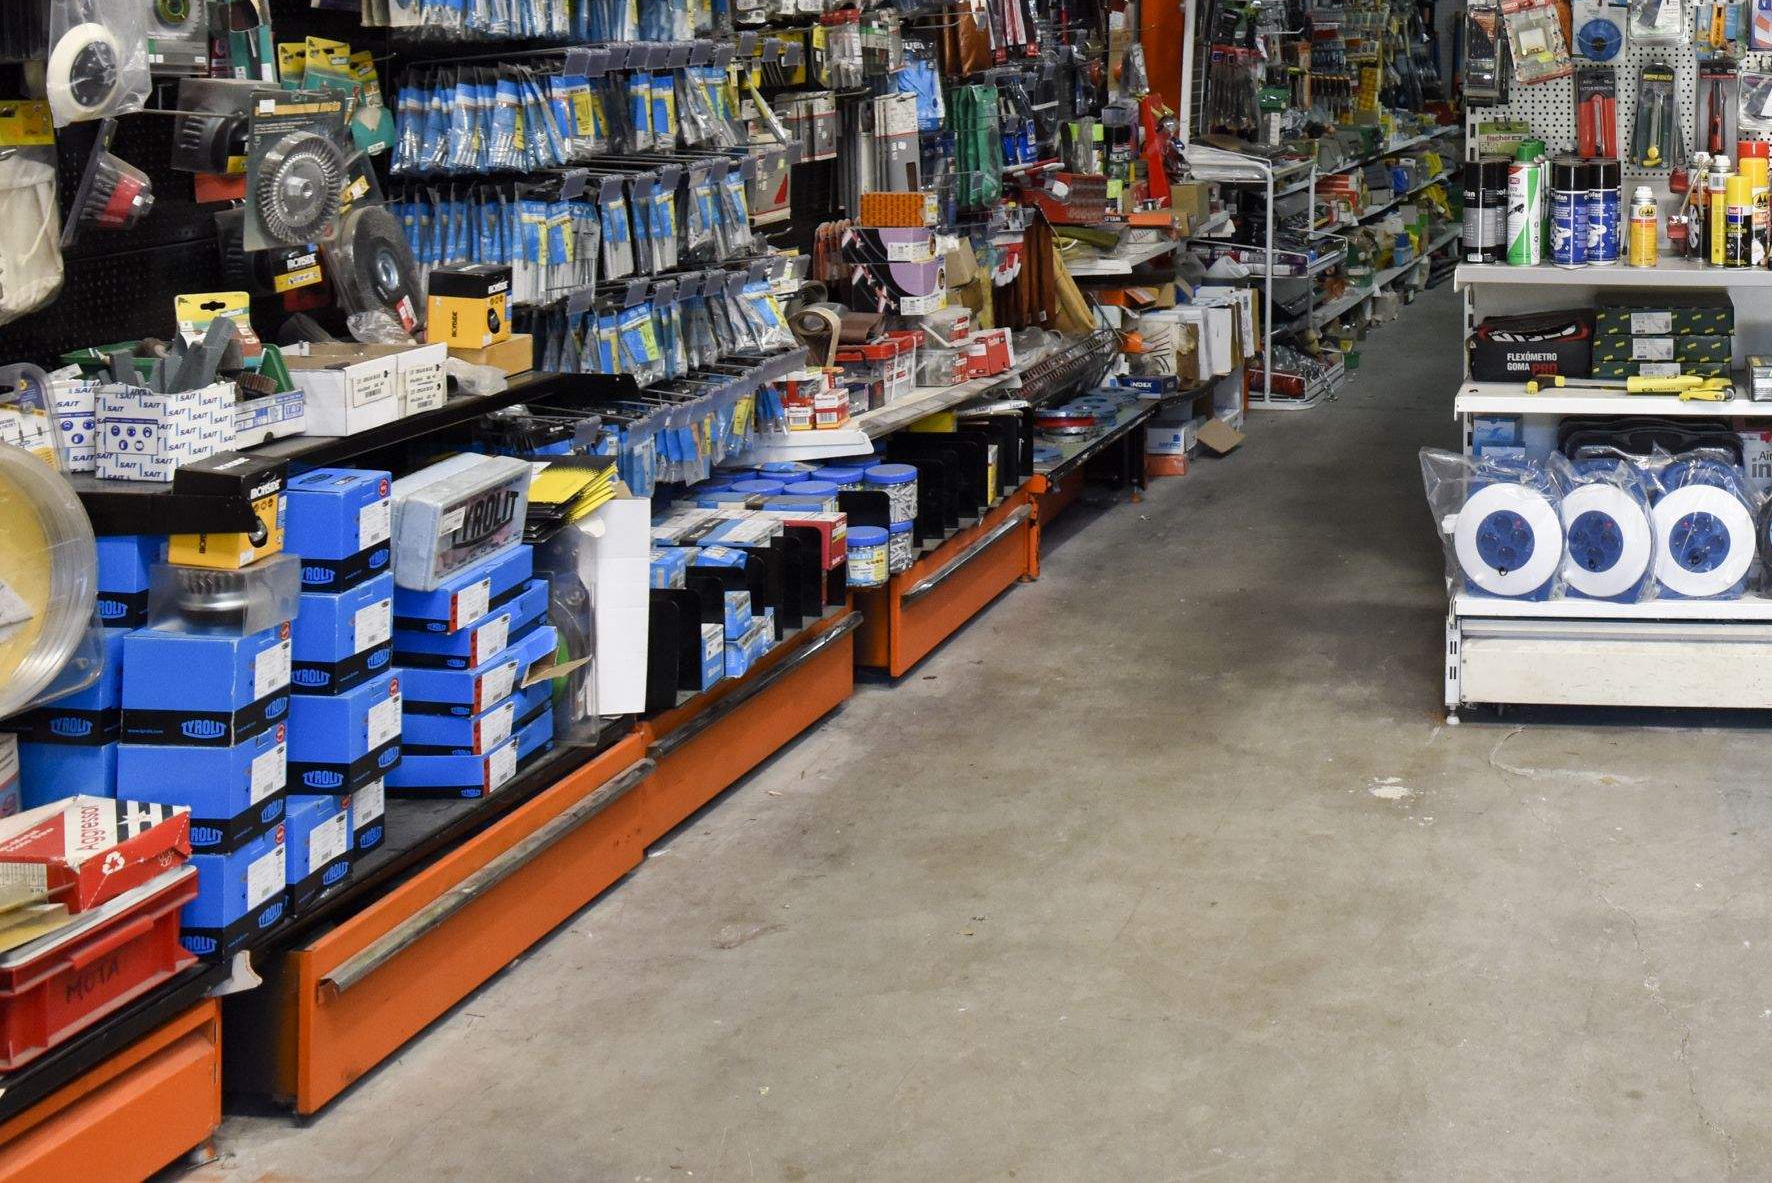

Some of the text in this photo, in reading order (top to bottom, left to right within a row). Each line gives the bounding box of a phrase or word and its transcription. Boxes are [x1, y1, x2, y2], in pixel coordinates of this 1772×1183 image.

[1506, 351, 1558, 362] FLEXÓMETRO
[1506, 362, 1558, 376] GOMA PRO
[50, 717, 93, 737] TYROLIT
[181, 719, 227, 738] TYROLIT
[302, 771, 344, 789] TYROLIT
[79, 803, 99, 852] Aggressor
